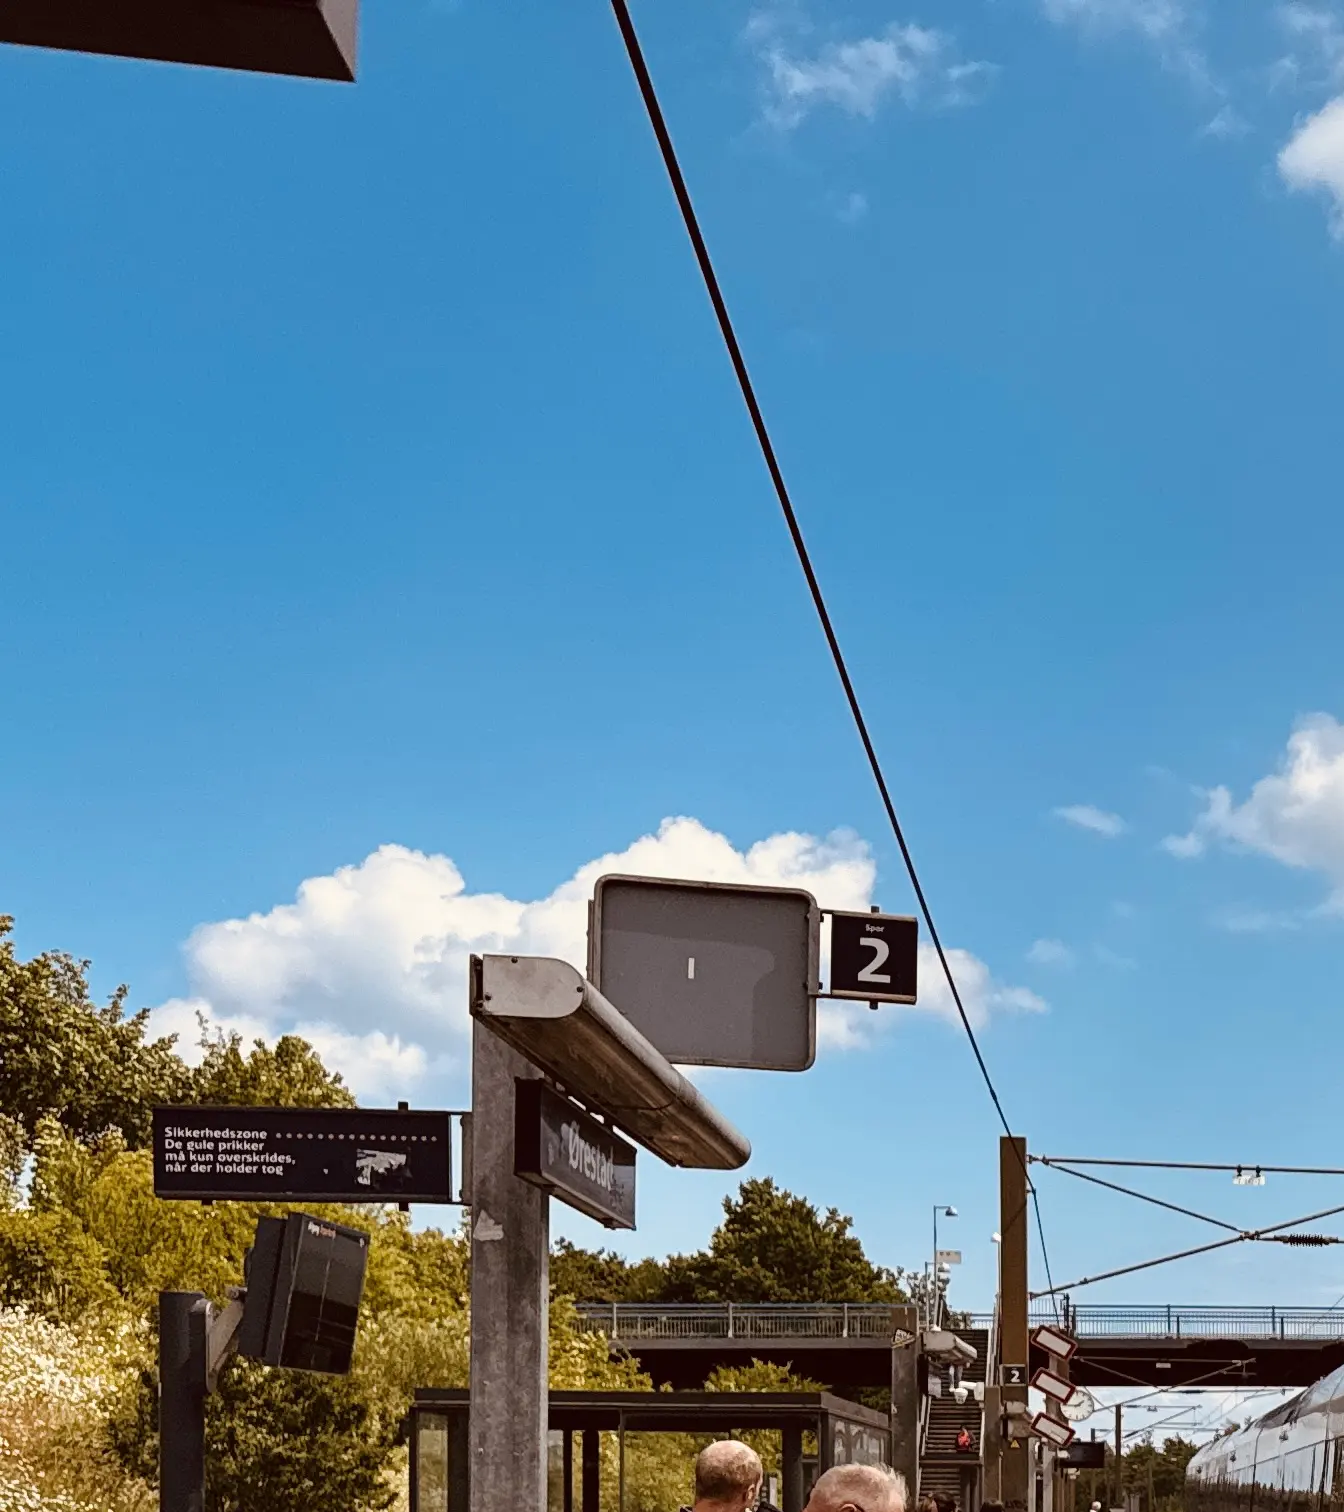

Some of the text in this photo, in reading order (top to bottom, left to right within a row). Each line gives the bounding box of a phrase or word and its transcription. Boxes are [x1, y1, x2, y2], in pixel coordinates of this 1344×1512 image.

[857, 937, 891, 983] 2
[164, 1127, 268, 1140] Sikkerhedszone
[165, 1139, 265, 1153] De gule prikker
[165, 1151, 296, 1165] må kun overskrides,
[165, 1162, 284, 1176] når der holder tog
[1010, 1370, 1020, 1383] 2
